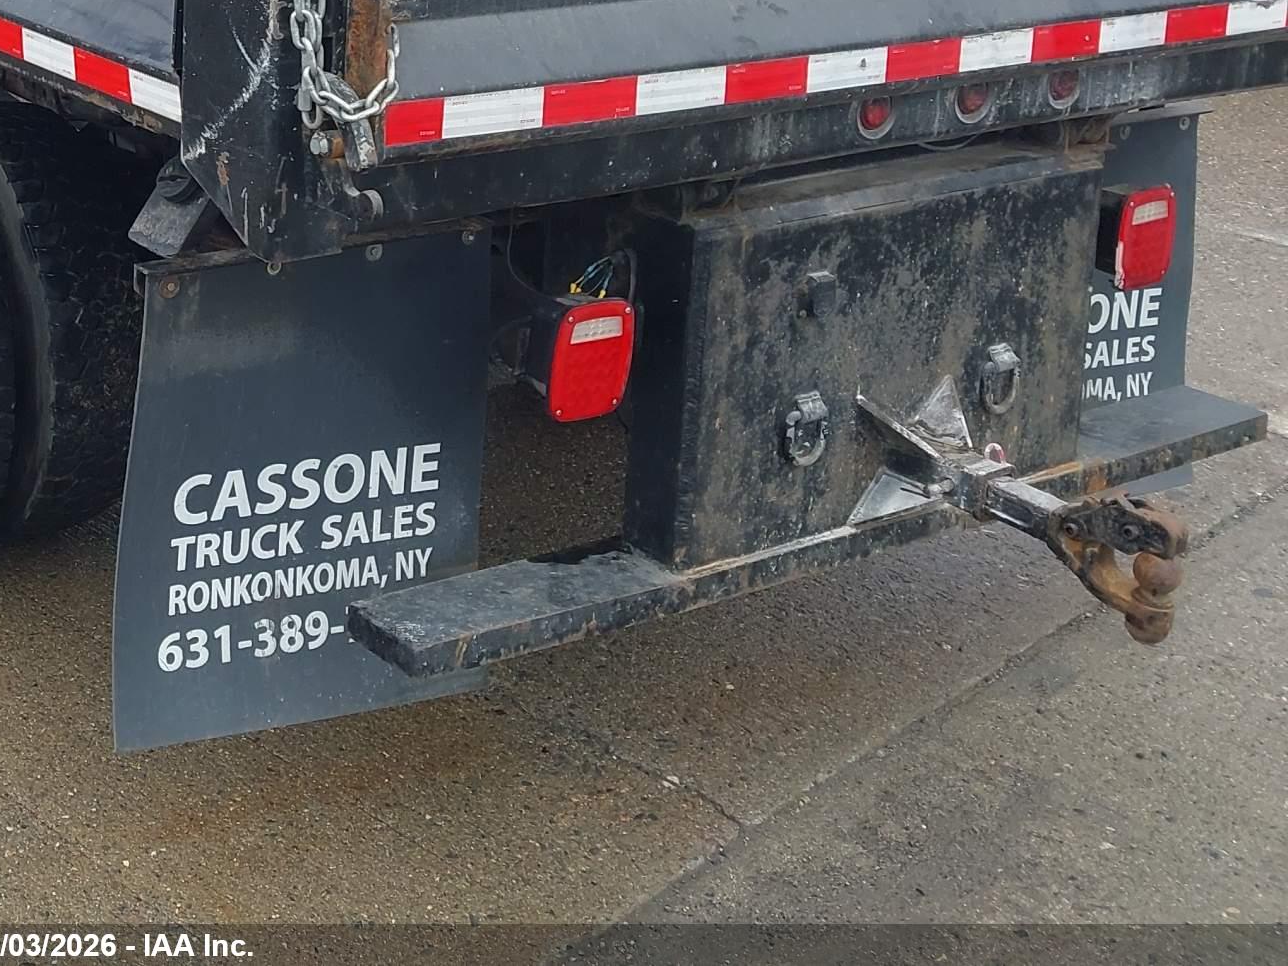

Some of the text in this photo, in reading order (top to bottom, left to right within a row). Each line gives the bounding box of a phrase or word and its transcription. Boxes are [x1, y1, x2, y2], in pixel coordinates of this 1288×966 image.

[1087, 287, 1162, 334] ONE
[1126, 372, 1153, 398] NY
[174, 443, 441, 525] CASSONE
[170, 502, 437, 572] TRUCK SALES
[168, 548, 433, 617] RONKONKOMA, NY
[158, 605, 355, 673] 631-389-
